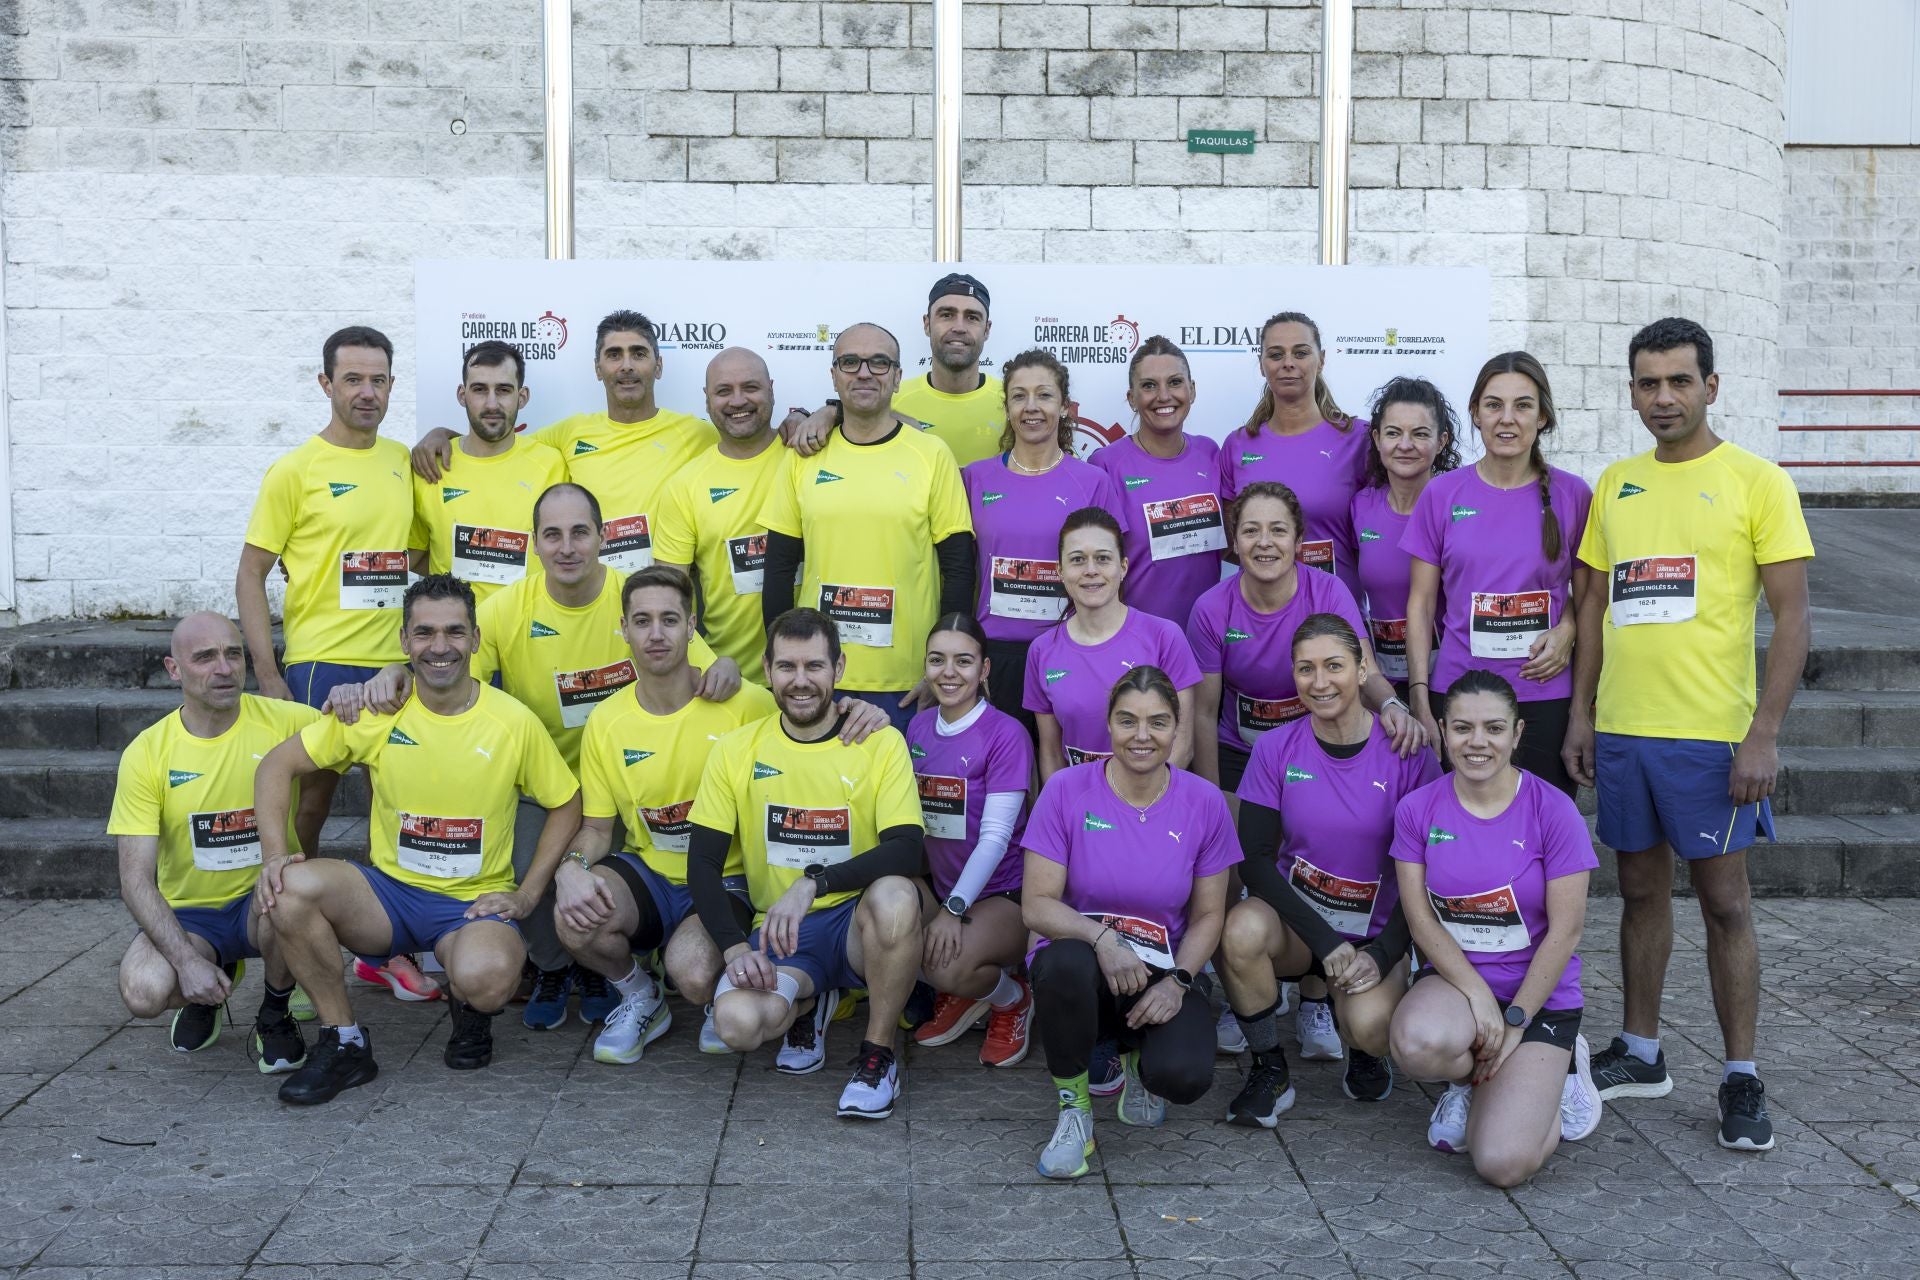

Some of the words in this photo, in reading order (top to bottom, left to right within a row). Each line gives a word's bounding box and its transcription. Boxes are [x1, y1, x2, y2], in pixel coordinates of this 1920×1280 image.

[1194, 137, 1248, 146] TAQUILLAS
[462, 322, 517, 339] CARRERA
[521, 322, 537, 339] DE
[1034, 326, 1089, 342] CARRERA
[1093, 326, 1109, 342] DE
[1180, 326, 1210, 345] EL
[511, 343, 556, 360] RESAS
[1061, 347, 1127, 363] EMPRESAS
[459, 532, 470, 542] 5K
[735, 545, 746, 555] 5K
[1617, 569, 1627, 582] 5K
[824, 591, 834, 602] 5K
[1477, 601, 1492, 612] 10K
[1512, 618, 1531, 626] INGLÉS
[561, 679, 575, 689] 10K
[772, 812, 783, 824] 5K
[198, 820, 211, 830] 5K
[235, 832, 256, 840] INGLÉS
[417, 839, 436, 847] CORTE
